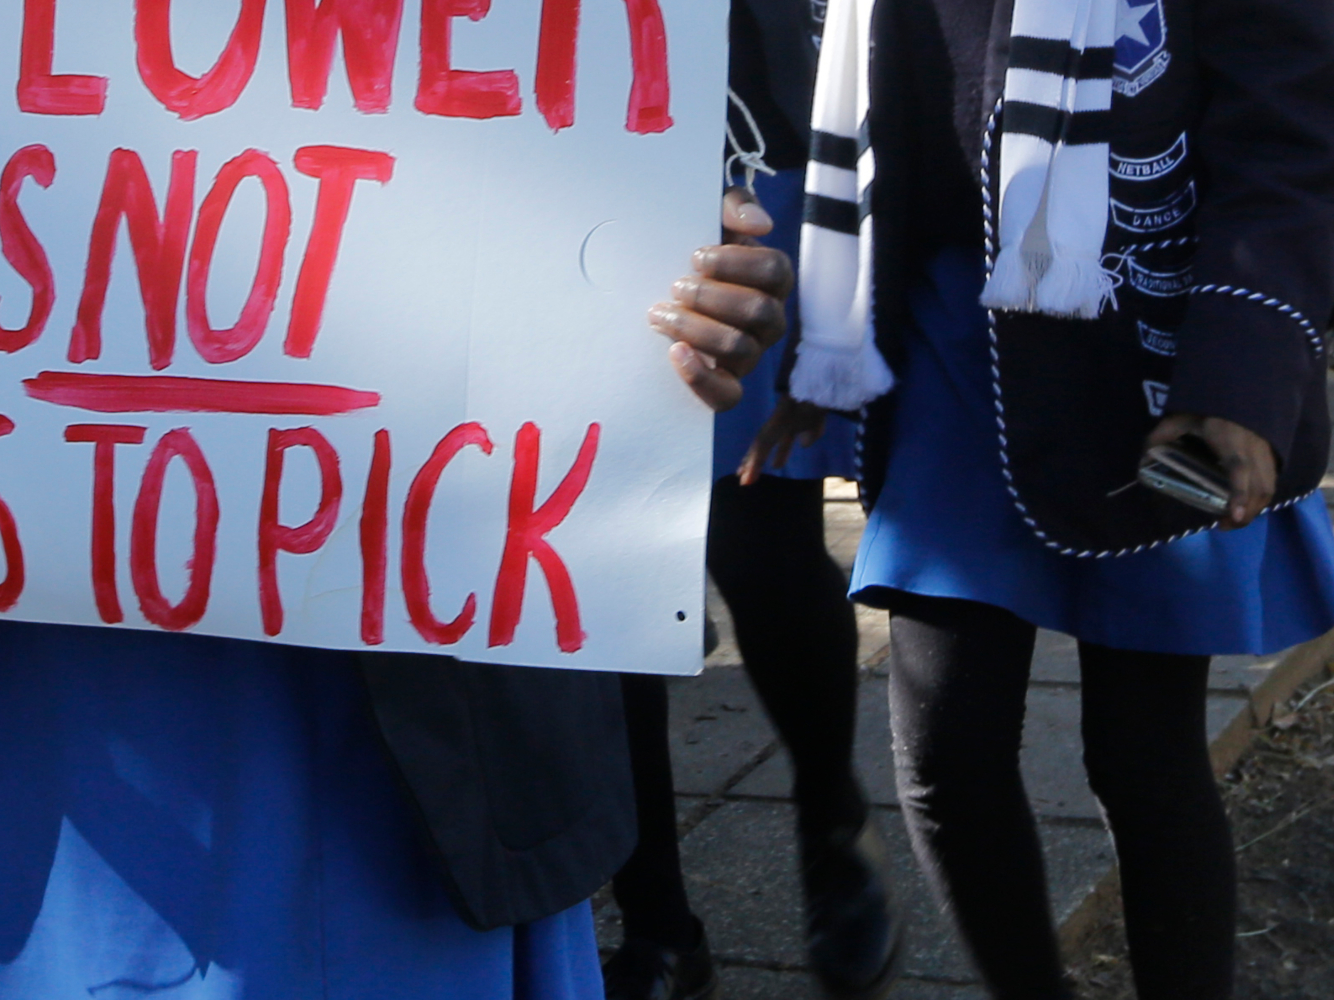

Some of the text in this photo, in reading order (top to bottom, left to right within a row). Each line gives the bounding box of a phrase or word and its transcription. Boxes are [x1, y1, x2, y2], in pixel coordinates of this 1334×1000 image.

[1117, 156, 1175, 176] NETBALL
[1133, 207, 1181, 227] DANCE
[69, 145, 395, 370] NOT
[65, 425, 219, 631] TO
[259, 422, 600, 652] PICK
